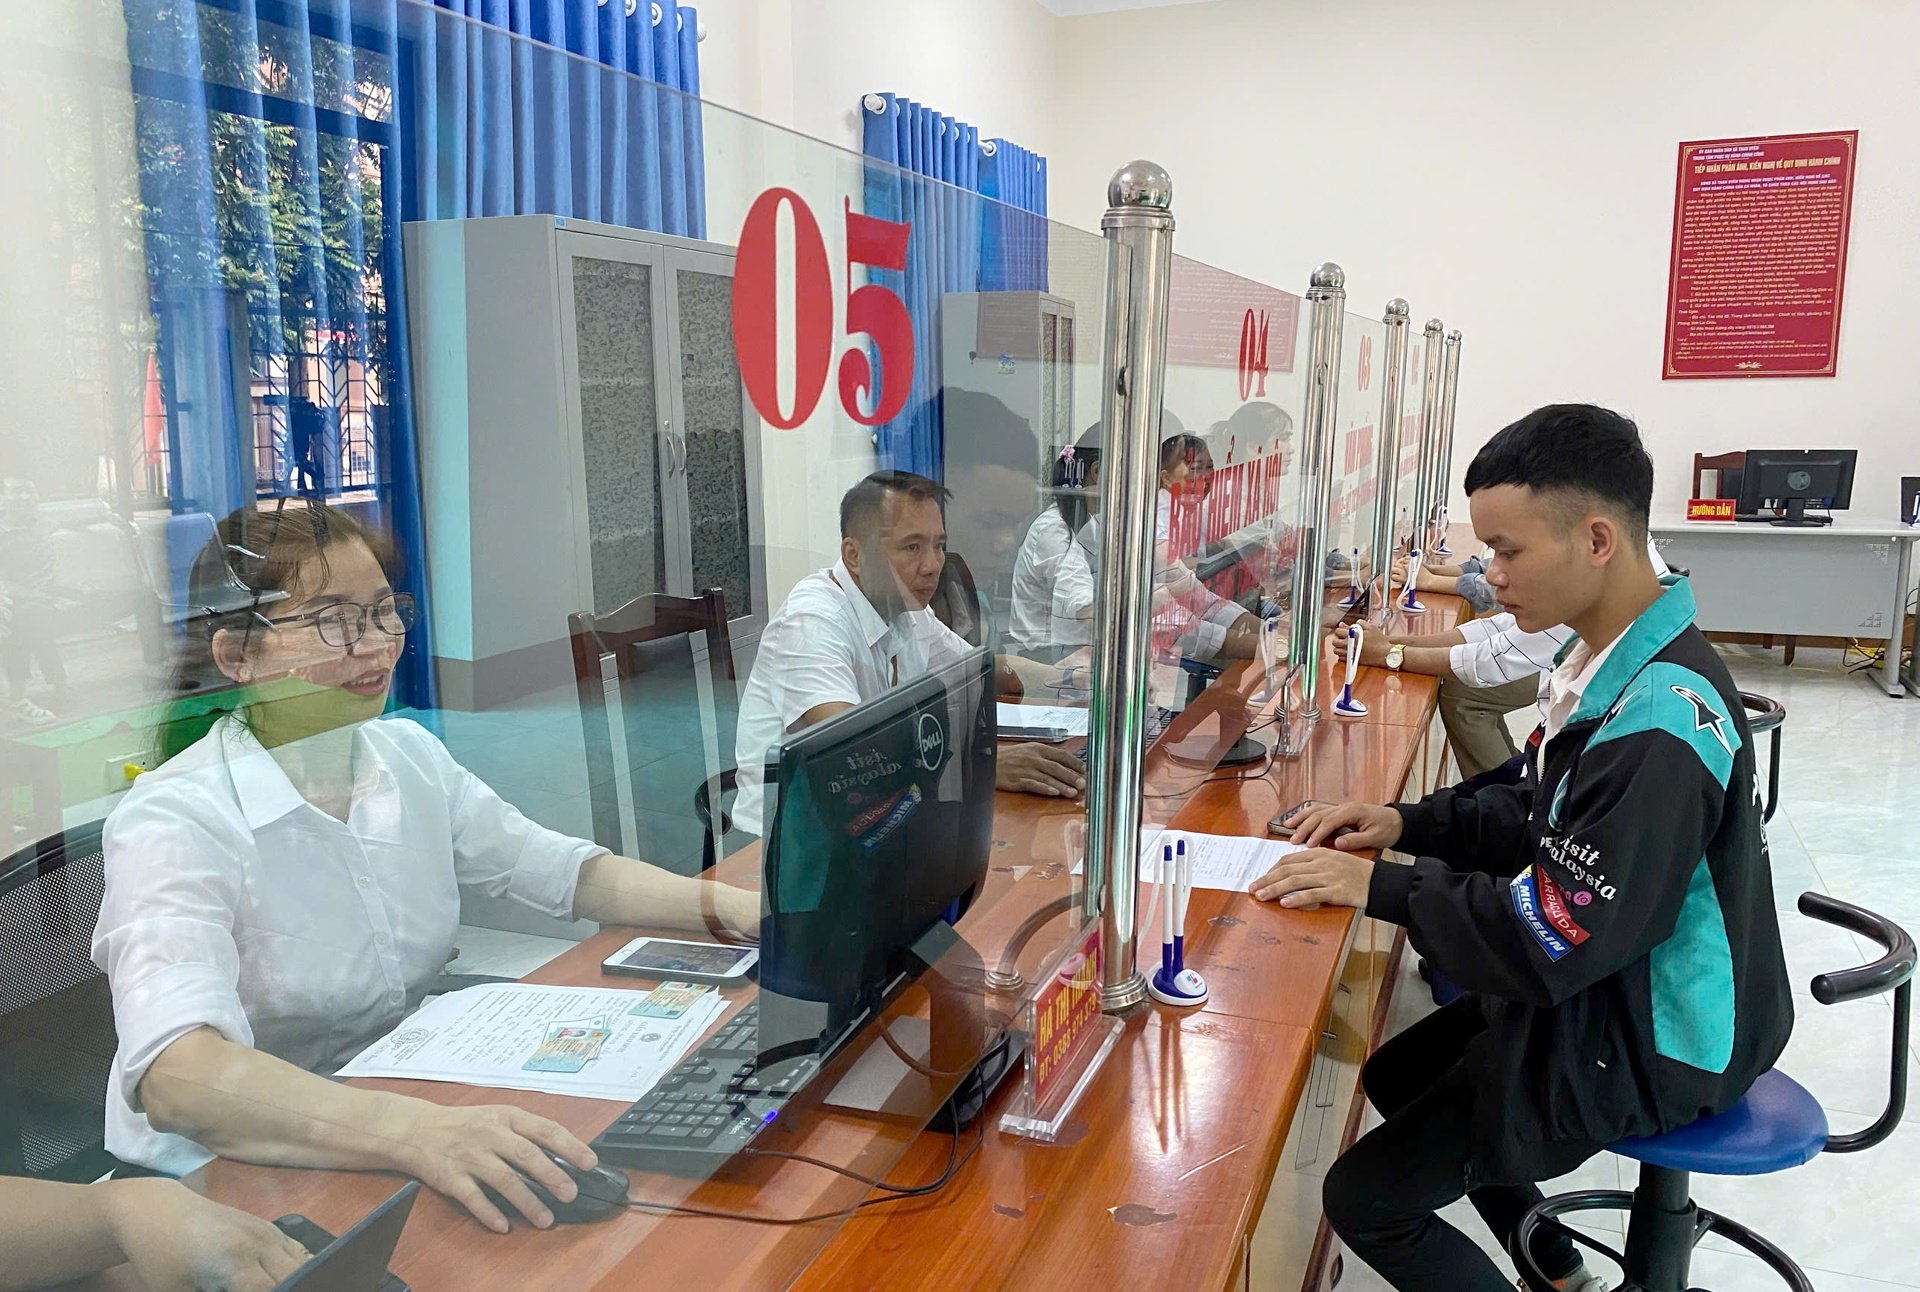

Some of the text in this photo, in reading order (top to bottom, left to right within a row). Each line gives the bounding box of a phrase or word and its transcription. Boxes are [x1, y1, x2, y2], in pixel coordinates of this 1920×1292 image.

[732, 187, 914, 430] 05
[1238, 308, 1270, 401] 04
[1205, 435, 1244, 545] HIỂM
[922, 731, 942, 752] DELL
[1519, 884, 1566, 952] MICHELIN
